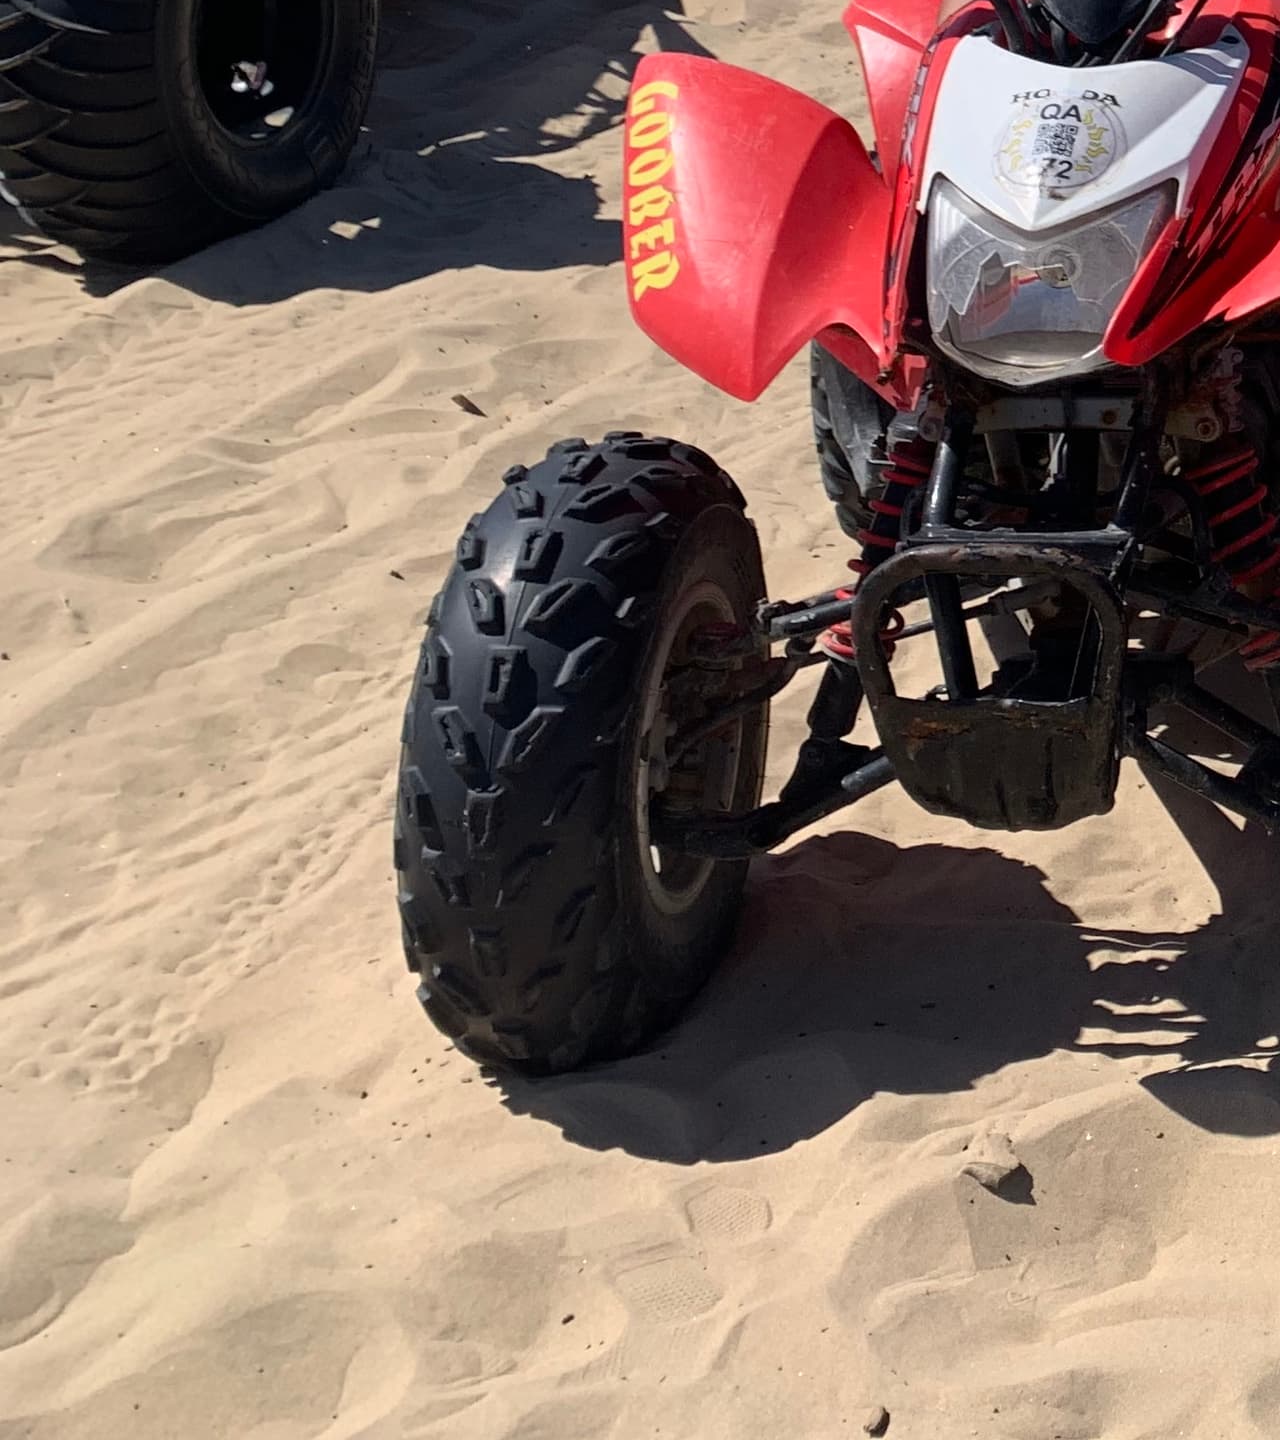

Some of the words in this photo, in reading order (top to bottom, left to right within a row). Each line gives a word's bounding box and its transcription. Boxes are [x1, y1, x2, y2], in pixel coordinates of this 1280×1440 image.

[1011, 88, 1121, 108] HODA
[1040, 103, 1082, 122] QA
[628, 80, 680, 302] GOOBER
